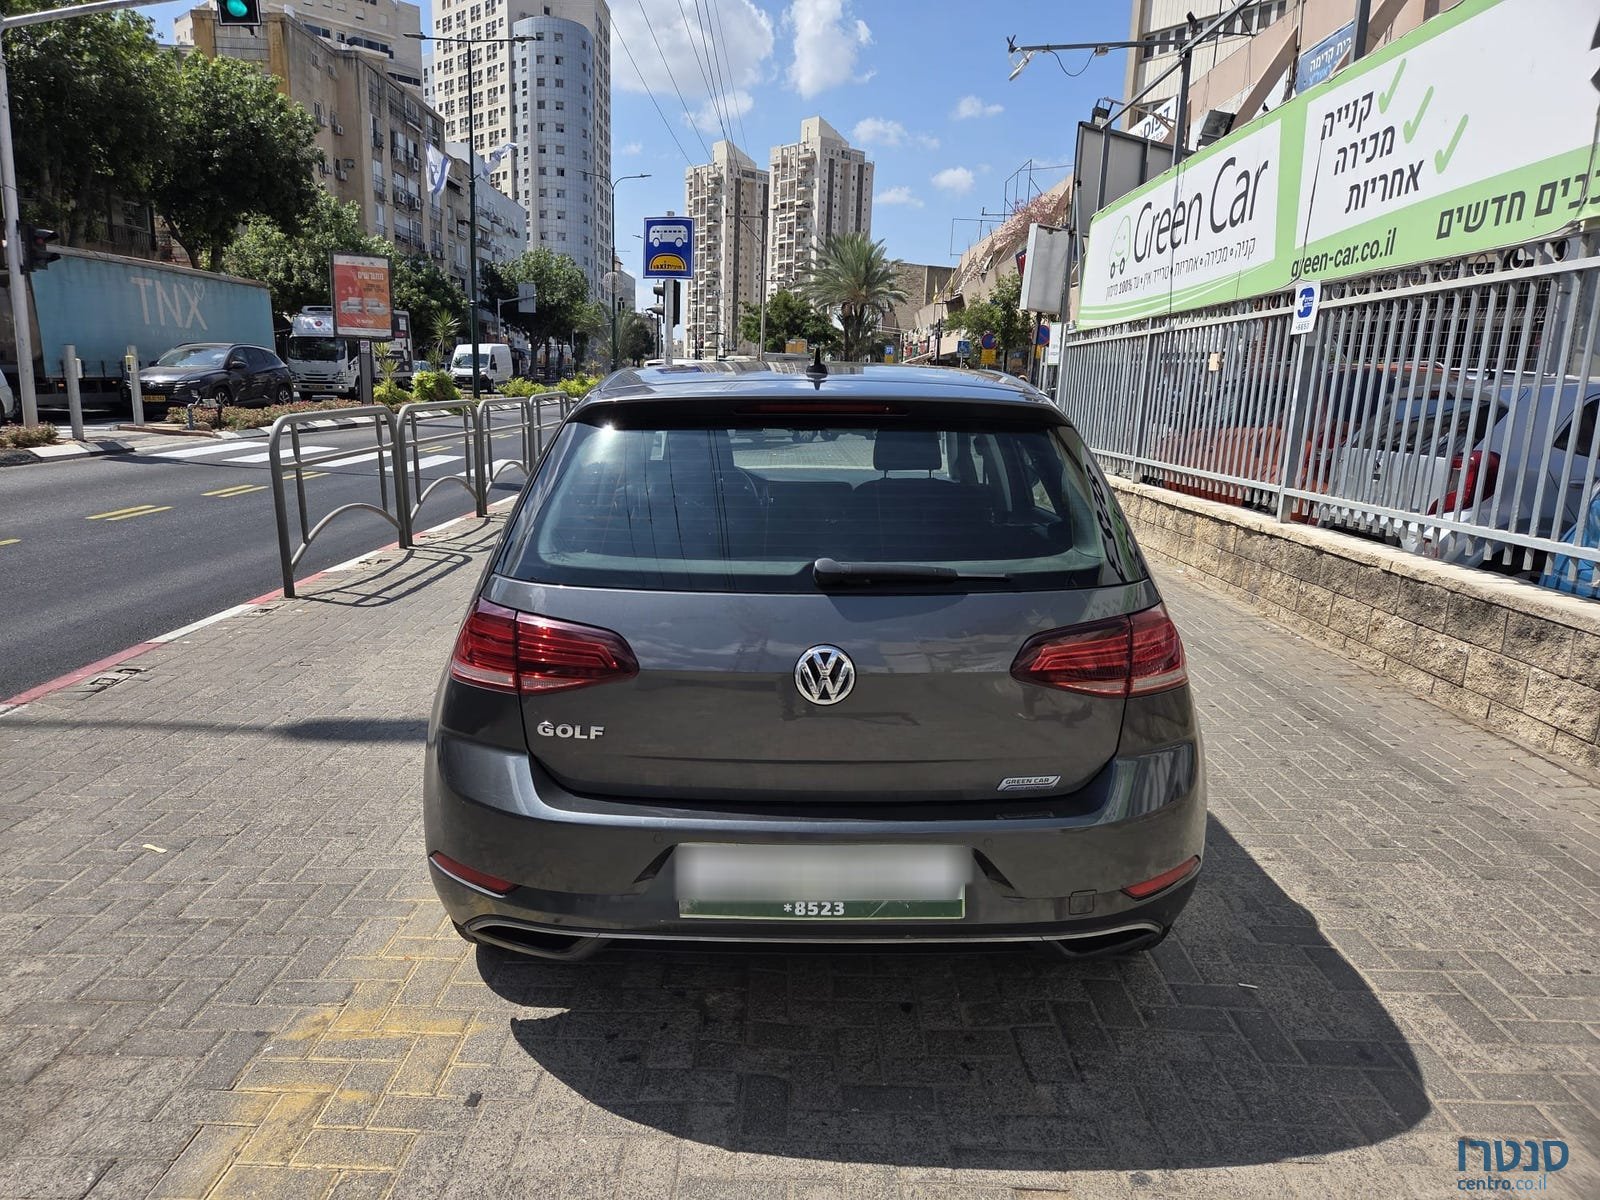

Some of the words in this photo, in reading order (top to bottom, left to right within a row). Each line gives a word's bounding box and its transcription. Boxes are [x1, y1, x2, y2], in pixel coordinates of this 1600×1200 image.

[1321, 90, 1374, 141] קנייה
[1333, 125, 1396, 176] מכירה
[1134, 192, 1203, 263] Green
[1210, 156, 1269, 234] Car
[1344, 159, 1425, 214] אחריות
[1436, 190, 1526, 241] חדשים
[1204, 246, 1228, 268] מכירה
[1234, 237, 1256, 260] קניה
[1291, 227, 1397, 279] green-car.co.il
[130, 276, 208, 331] TNX
[537, 721, 605, 740] GOLF
